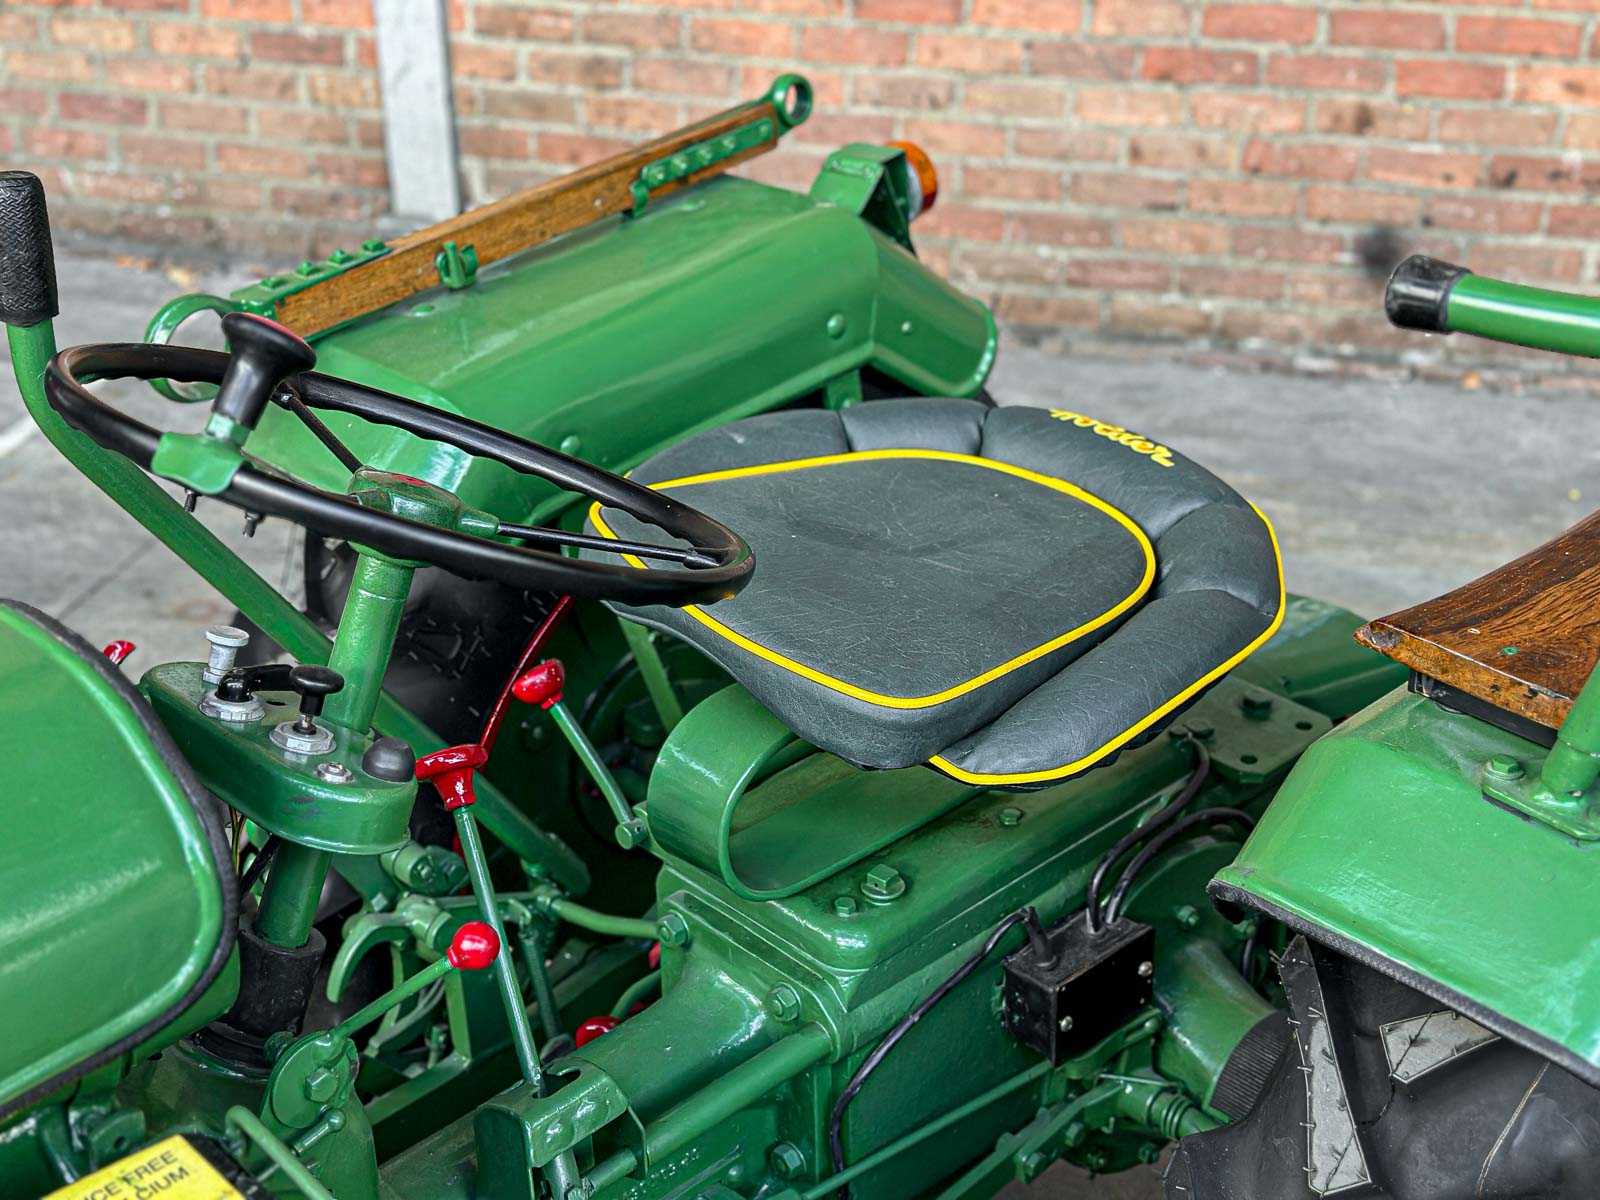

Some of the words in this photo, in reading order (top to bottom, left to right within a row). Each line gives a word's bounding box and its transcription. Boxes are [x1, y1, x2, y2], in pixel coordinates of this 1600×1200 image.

[83, 1181, 122, 1200] CE
[121, 1150, 178, 1186] FREE
[123, 1166, 189, 1200] CIUM
